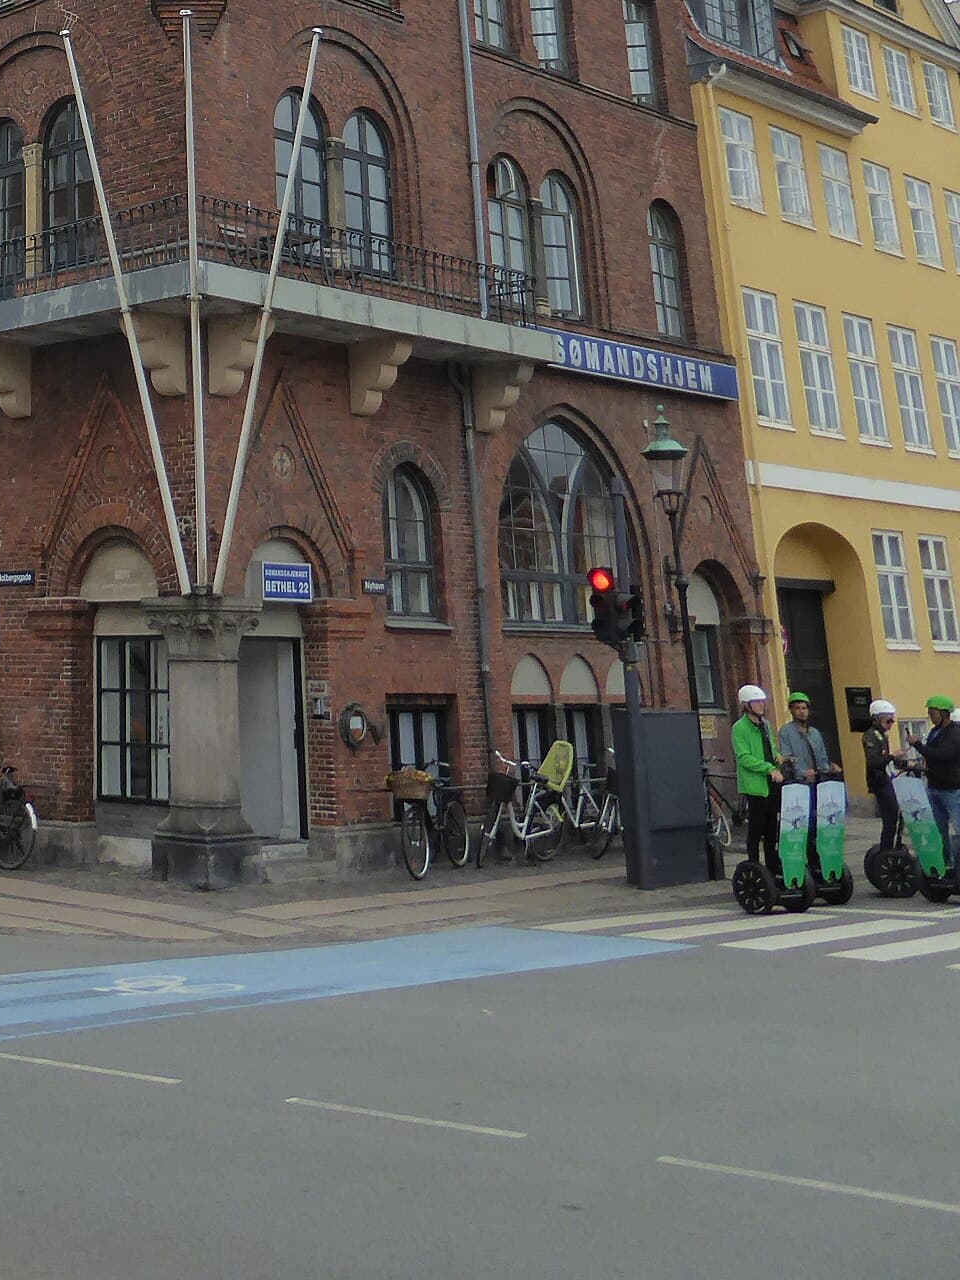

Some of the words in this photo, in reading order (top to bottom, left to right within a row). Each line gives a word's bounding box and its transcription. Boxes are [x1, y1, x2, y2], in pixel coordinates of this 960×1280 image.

[552, 334, 713, 392] SØMANDSHJEM
[265, 580, 297, 593] BETHEL
[298, 582, 309, 594] 22
[364, 581, 385, 594] Nyhavn
